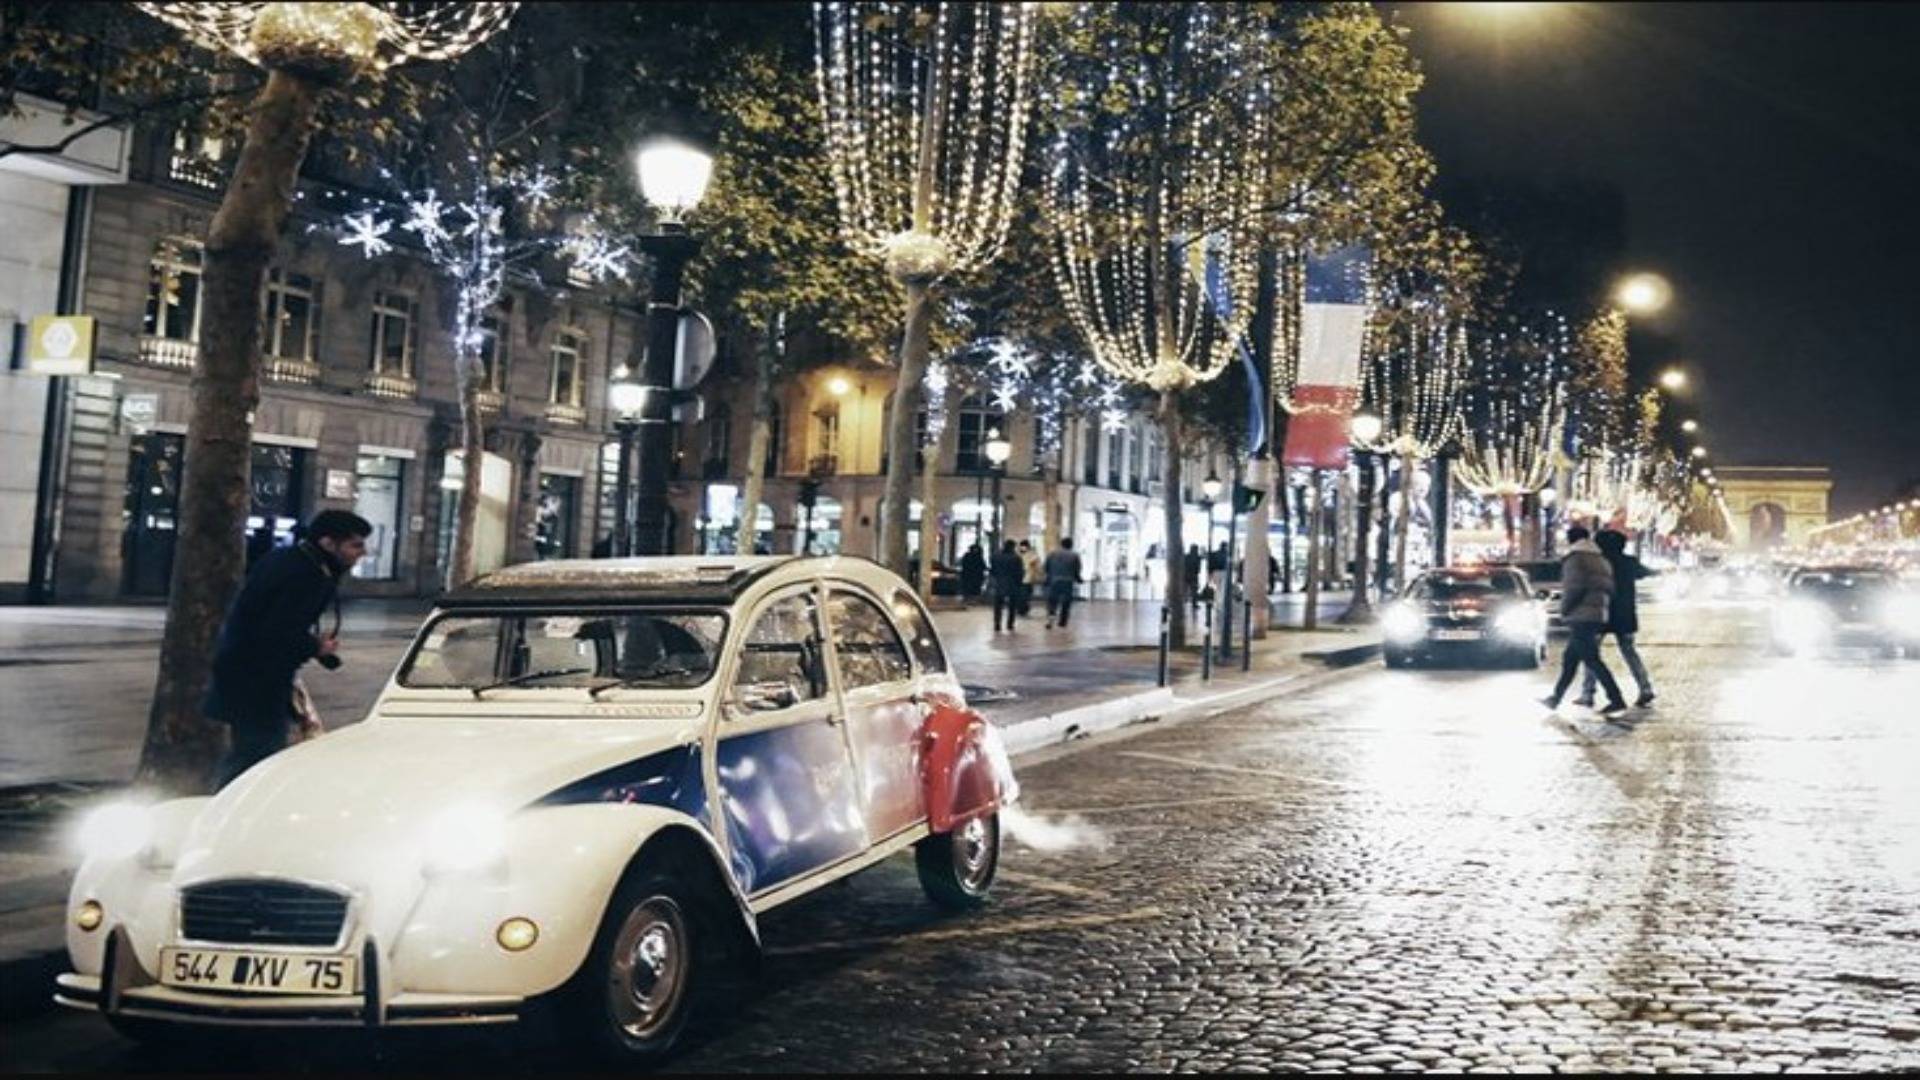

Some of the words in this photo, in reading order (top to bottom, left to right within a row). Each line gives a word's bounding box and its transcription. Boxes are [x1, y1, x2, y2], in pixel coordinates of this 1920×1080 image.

[174, 953, 219, 982] 544
[232, 957, 288, 987] XV
[306, 960, 342, 990] 75
